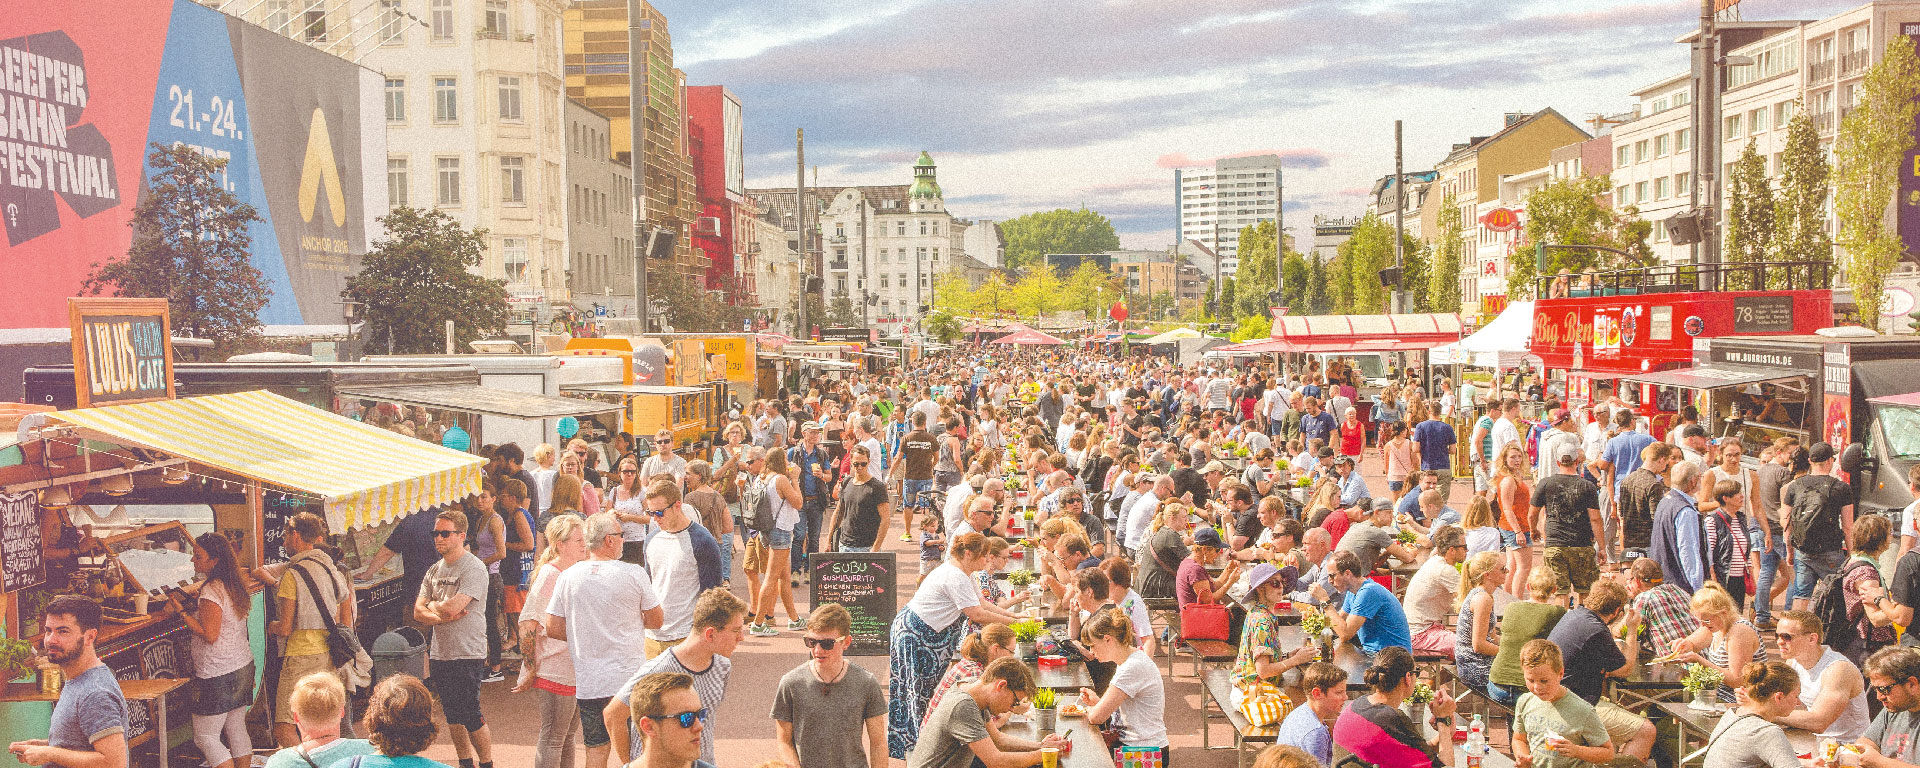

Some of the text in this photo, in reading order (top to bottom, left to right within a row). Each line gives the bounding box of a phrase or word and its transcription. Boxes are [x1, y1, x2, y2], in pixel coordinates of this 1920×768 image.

[170, 85, 243, 140] 21.-24.
[302, 235, 332, 252] ANCHOR
[1736, 306, 1753, 322] 78
[1535, 312, 1559, 352] Big
[1562, 312, 1594, 344] Ben
[84, 321, 138, 396] LULUS
[1726, 352, 1792, 366] WWW.BURRISTAS.DE
[832, 560, 867, 574] SUBU
